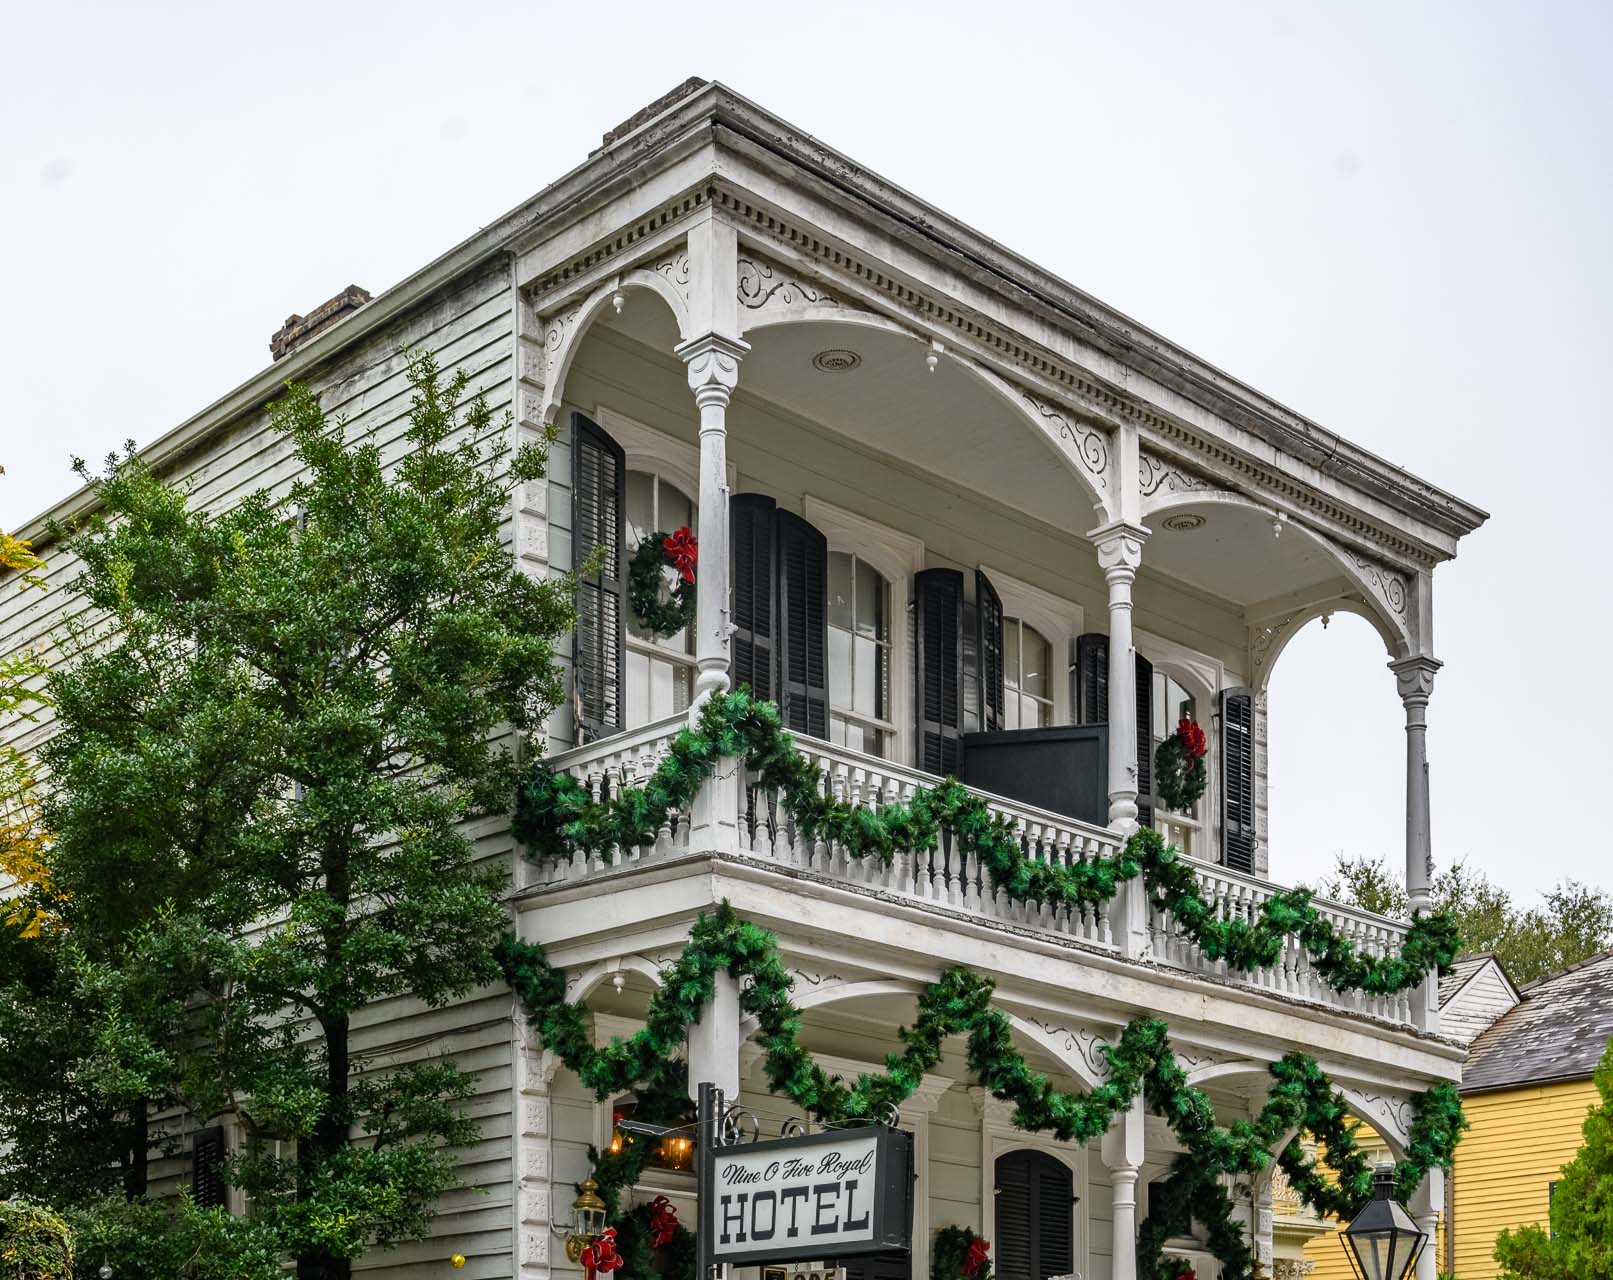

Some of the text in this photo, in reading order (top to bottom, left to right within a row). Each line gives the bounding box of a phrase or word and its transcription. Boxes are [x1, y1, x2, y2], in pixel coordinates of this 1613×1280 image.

[722, 1163, 760, 1185] Nine
[782, 1157, 814, 1180] Five
[817, 1150, 875, 1180] Royal
[719, 1179, 870, 1245] HOTEL
